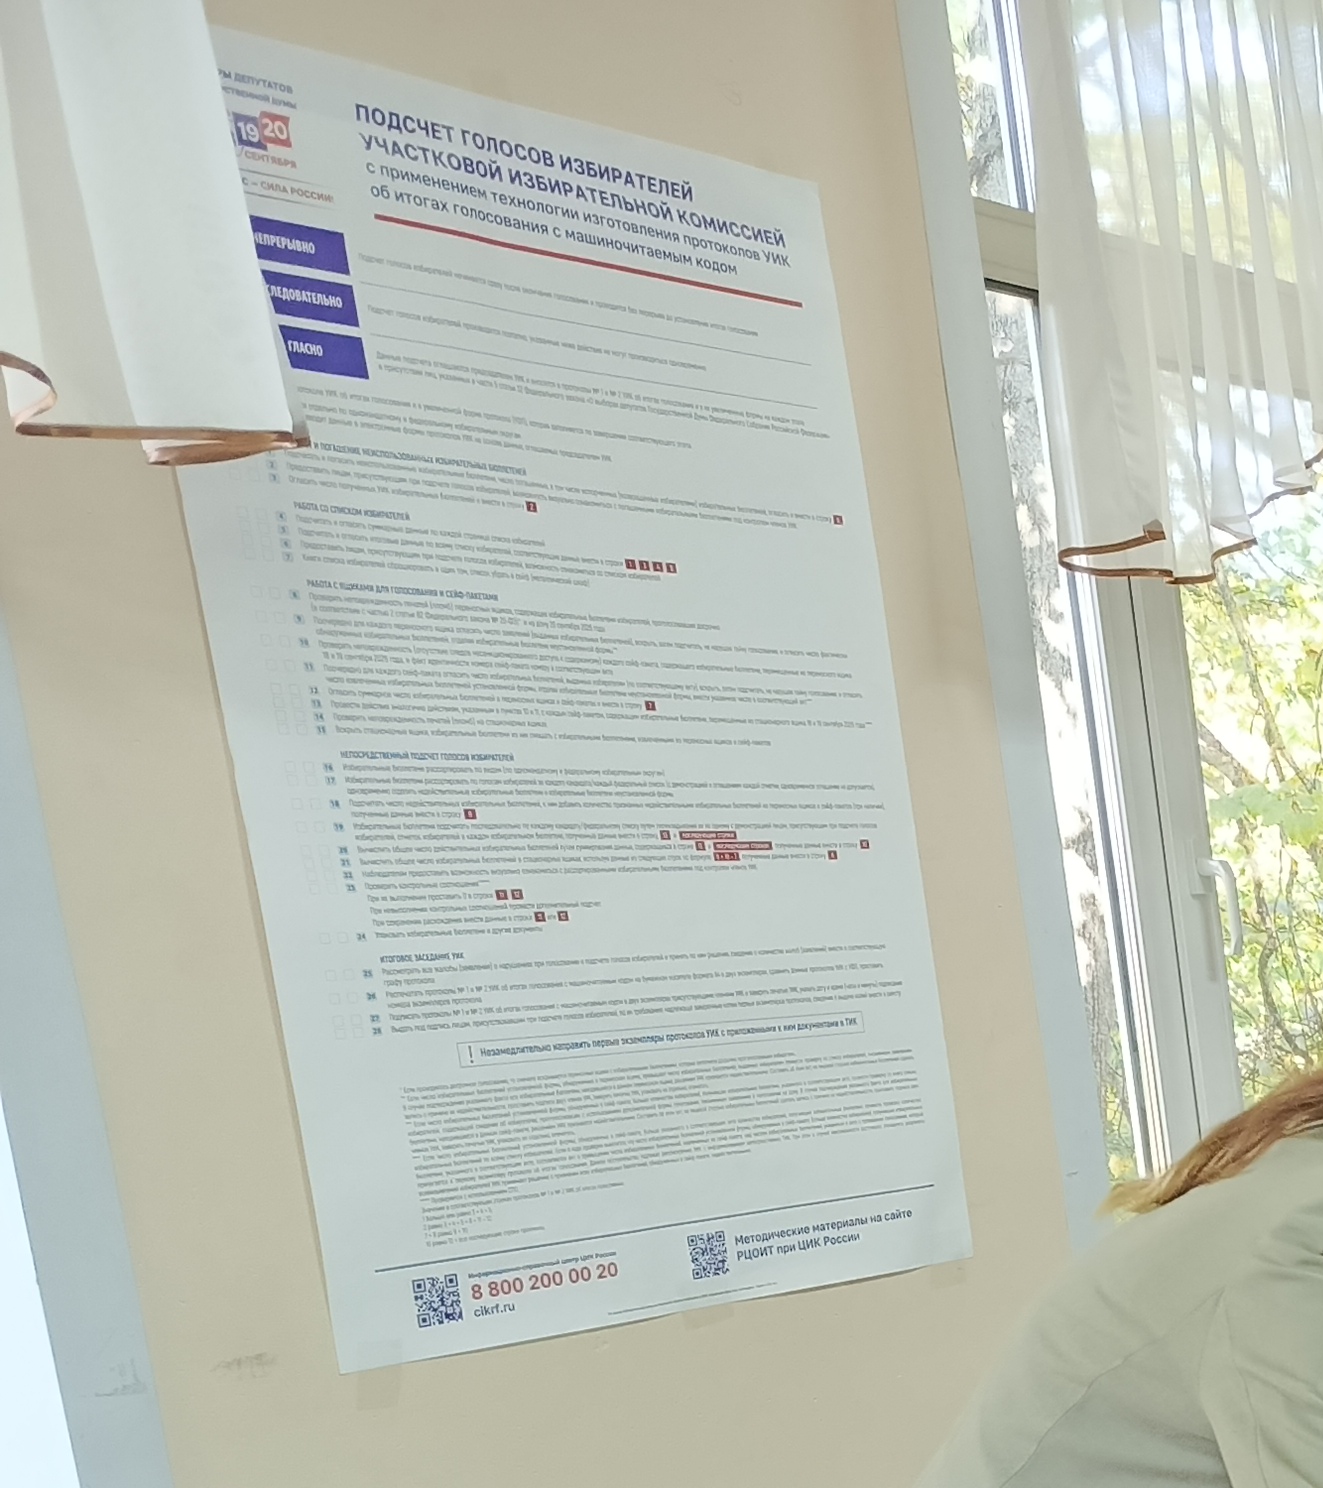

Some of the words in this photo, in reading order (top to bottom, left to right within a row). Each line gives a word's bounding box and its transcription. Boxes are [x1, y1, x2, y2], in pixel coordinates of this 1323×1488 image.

[234, 72, 294, 95] ДЕПУТАТОВ
[237, 121, 259, 144] 19
[262, 119, 288, 140] 20
[244, 151, 298, 169] СЕНТЯБРЯ
[355, 102, 454, 144] ПОДСЧЕТ
[461, 128, 554, 169] ГОЛОСОВ
[559, 153, 693, 202] ИЗБИРАТЕЛЕЙ
[260, 181, 289, 196] СИЛА
[359, 131, 503, 184] УЧАСТКОВОЙ
[508, 167, 673, 223] ИЗБИРАТЕЛЬНОЙ
[677, 207, 787, 249] КОМИССИЕЙ
[366, 161, 376, 175] с
[380, 164, 483, 201] применением
[487, 189, 579, 220] технологии
[583, 212, 681, 243] изготовления
[683, 234, 760, 261] протоколов
[762, 249, 792, 269] УИК
[371, 184, 391, 200] об
[395, 189, 449, 213] итогах
[453, 203, 549, 236] голосования
[553, 226, 562, 238] с
[565, 229, 693, 267] машиночитаемым
[696, 257, 738, 276] кодом
[287, 339, 324, 357] ГЛАСНО
[735, 1224, 810, 1246] Методические
[812, 1217, 868, 1234] материалы
[870, 1215, 882, 1223] на
[884, 1208, 912, 1221] сайте
[594, 1251, 617, 1259] России
[736, 1243, 774, 1261] РЦОИТ
[776, 1244, 796, 1255] при
[798, 1237, 821, 1251] ЦИК
[823, 1232, 861, 1246] России
[471, 1283, 483, 1300] 8
[488, 1277, 524, 1297] 800
[528, 1270, 563, 1290] 200
[568, 1266, 591, 1283] 00
[596, 1262, 618, 1280] 20
[473, 1303, 516, 1317] cikrf.ru
